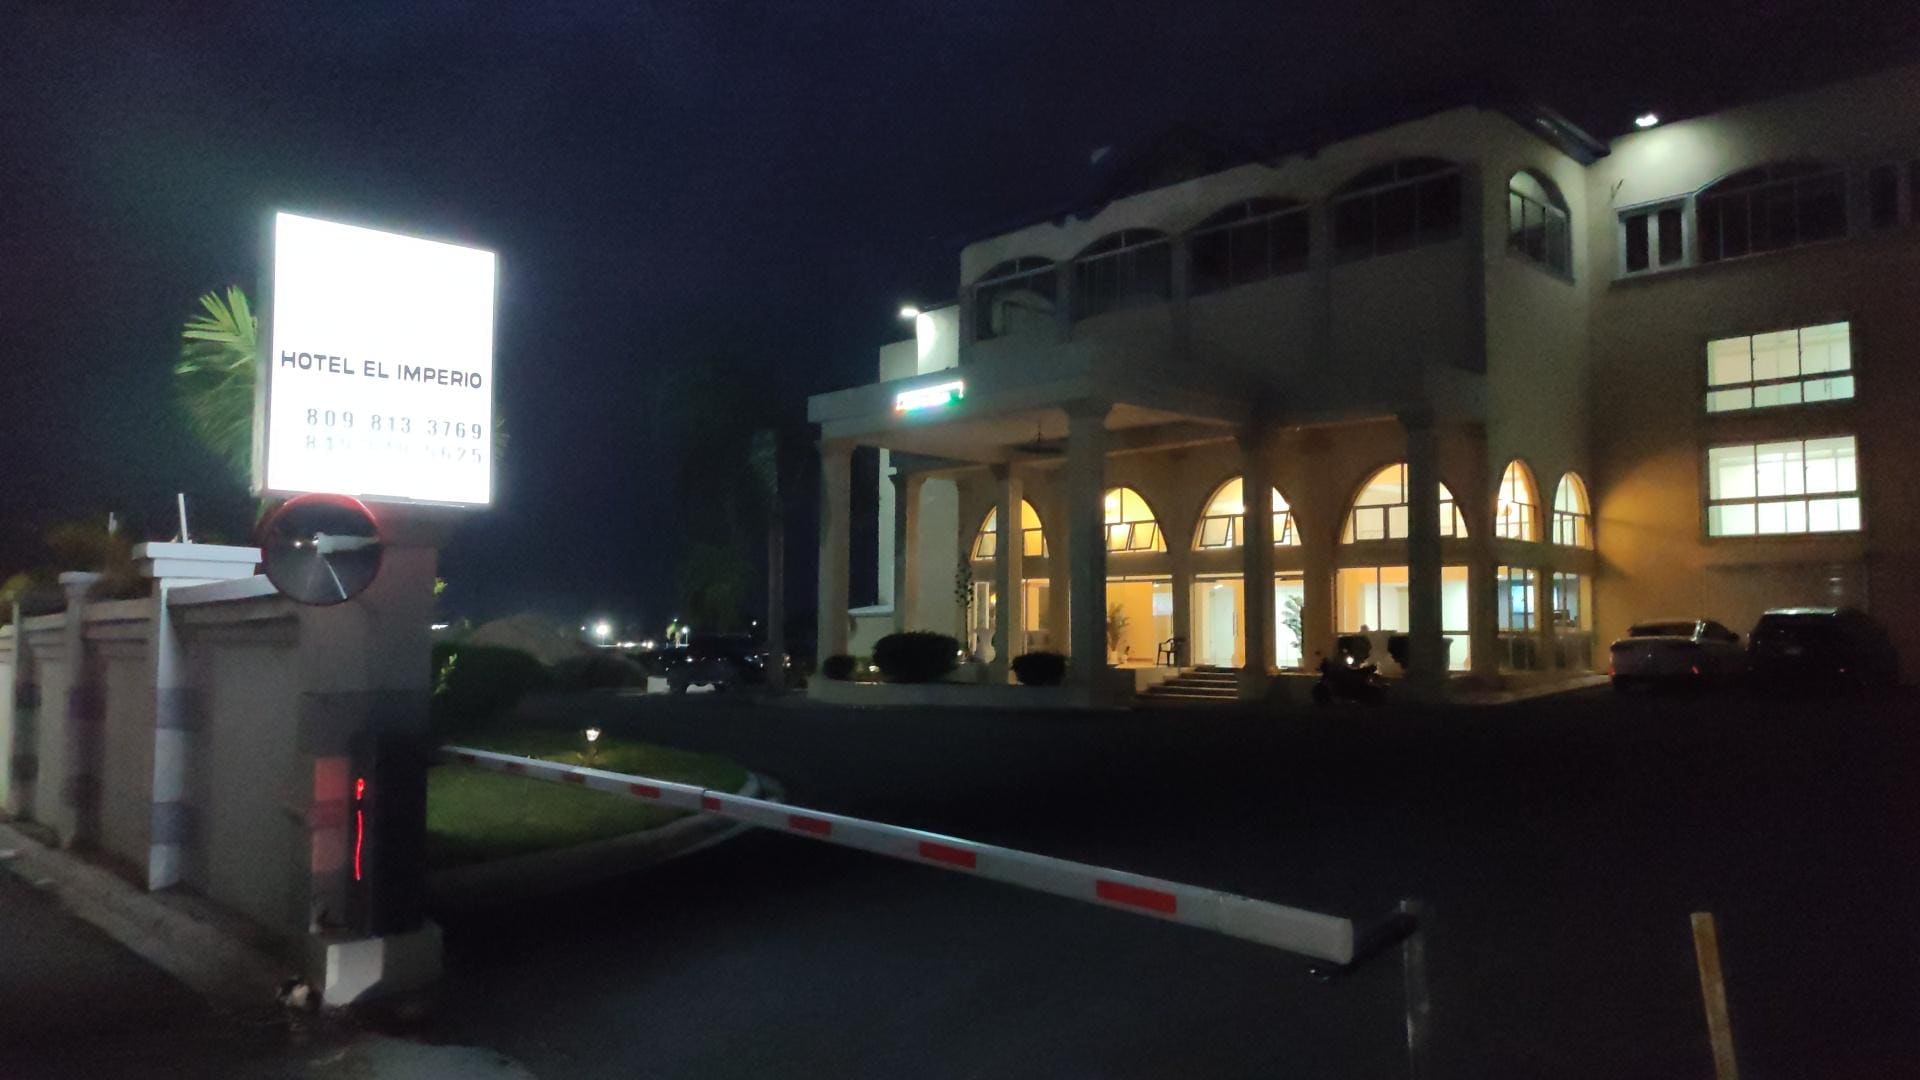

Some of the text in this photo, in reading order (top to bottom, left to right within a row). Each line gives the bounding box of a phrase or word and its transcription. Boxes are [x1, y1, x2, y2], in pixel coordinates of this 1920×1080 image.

[281, 350, 482, 389] HOTEL EL IMPERIO
[306, 408, 482, 440] 809 813 3769
[424, 444, 482, 464] 625
